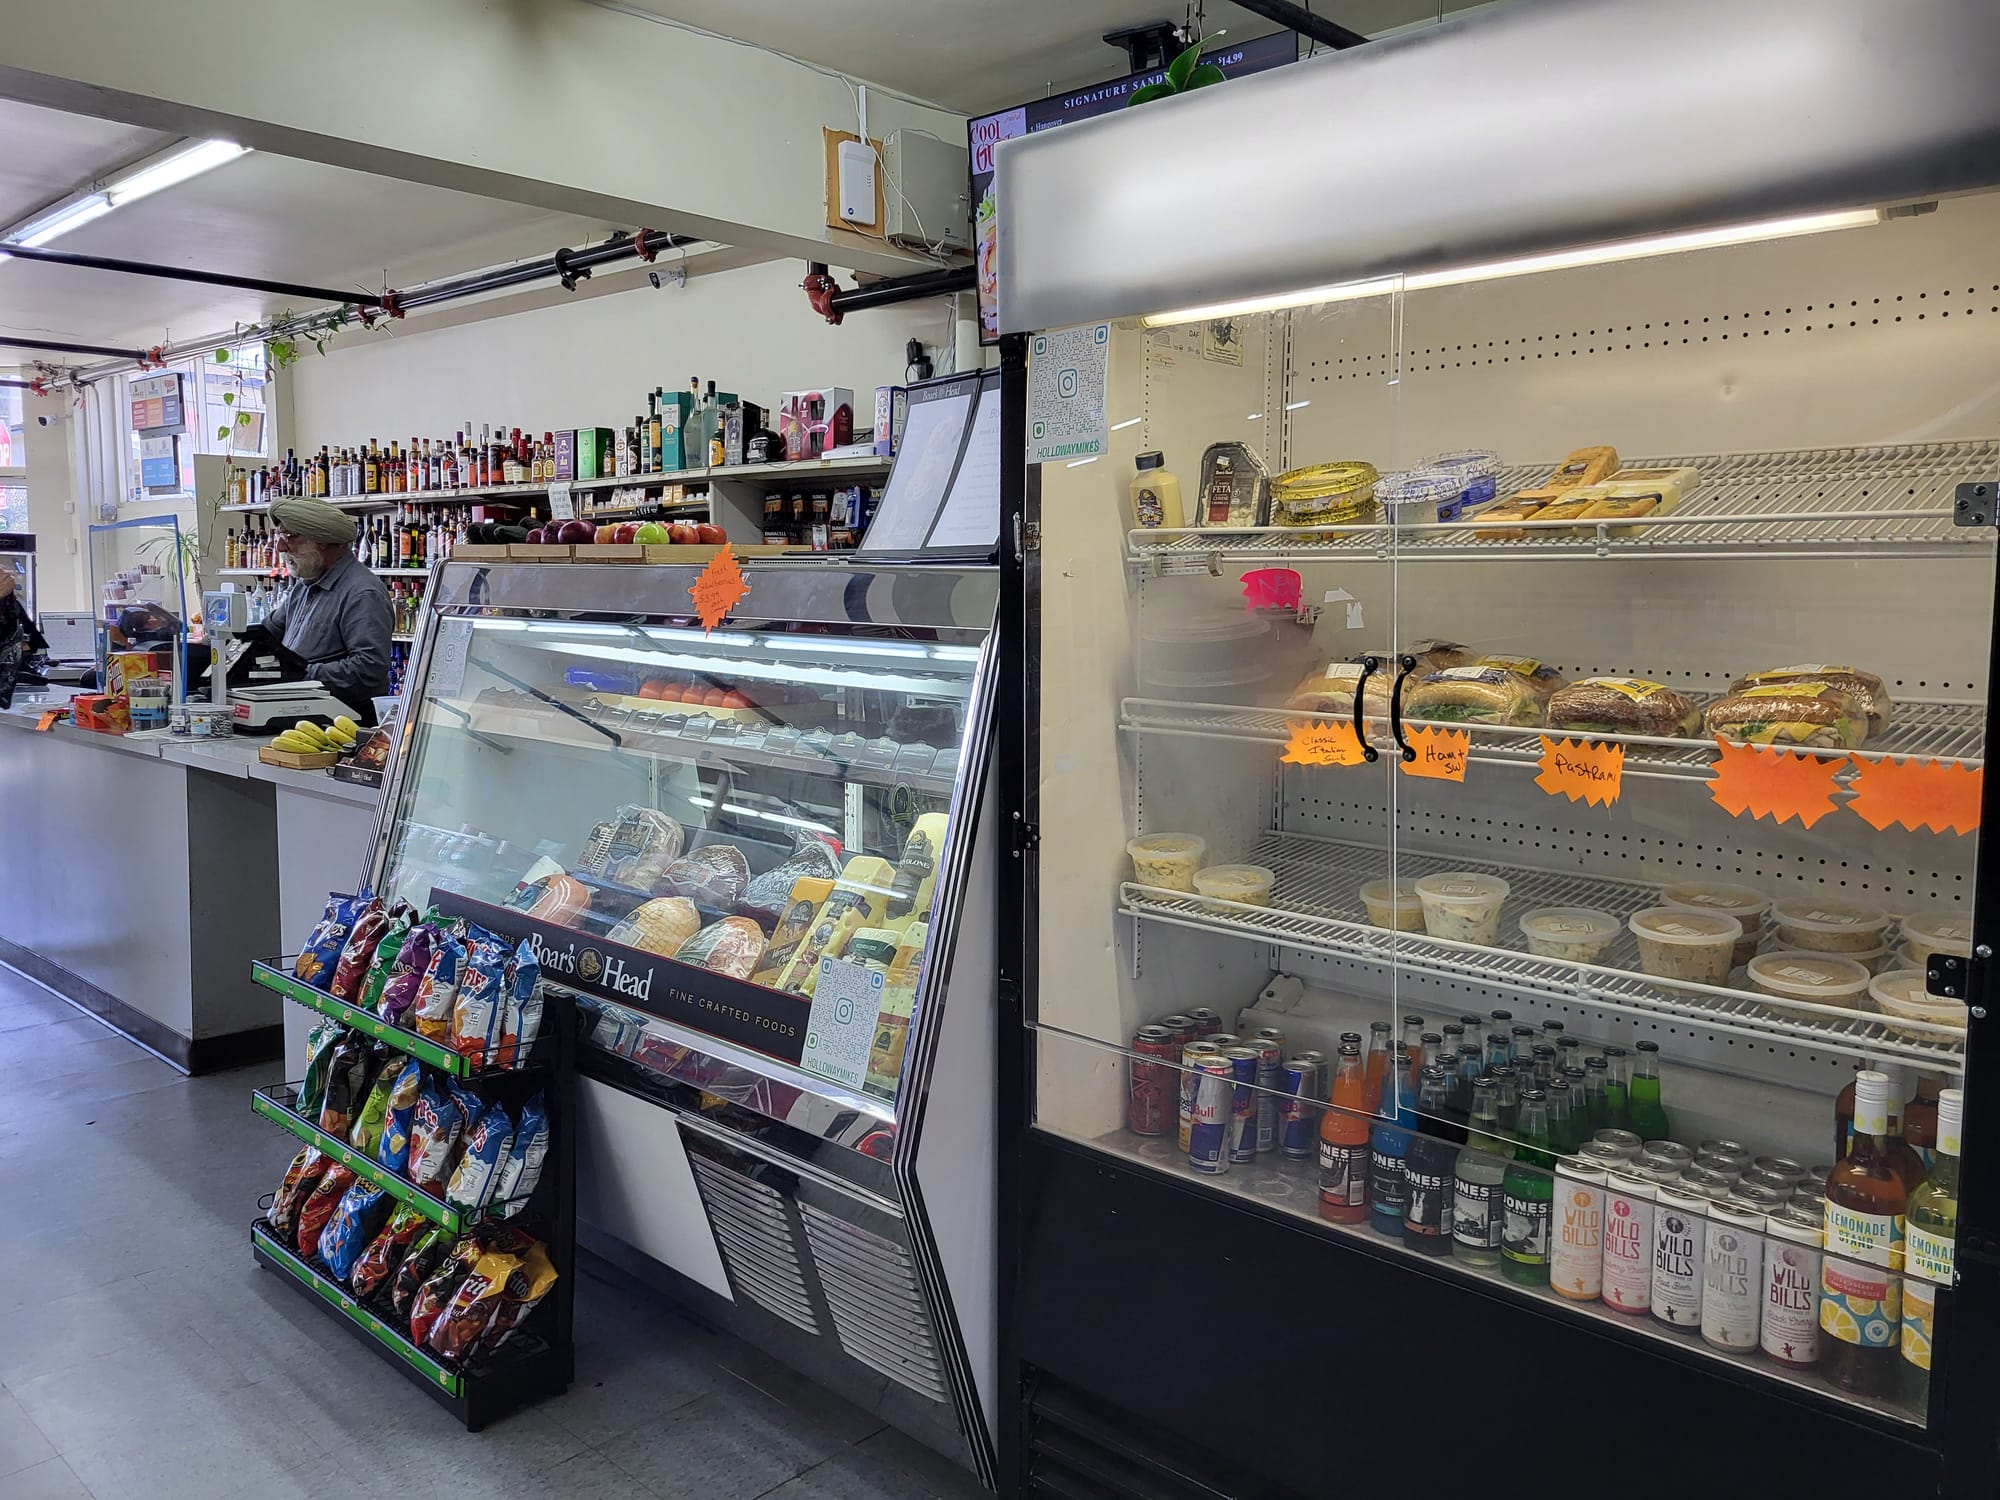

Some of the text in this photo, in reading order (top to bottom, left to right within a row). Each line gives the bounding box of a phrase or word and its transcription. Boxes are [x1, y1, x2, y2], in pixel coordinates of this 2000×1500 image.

[1064, 51, 1244, 109] SIGNATURE SAND $14.99
[976, 143, 995, 171] GU
[1036, 438, 1100, 459] HOLLOWAYMIKES
[1212, 485, 1231, 493] FETA
[530, 932, 796, 1038] Boar's Head FINE CRAFTED FOODS
[806, 1055, 860, 1085] HOLLOWAYMIKES
[1320, 1141, 1350, 1159] ONES
[1372, 1151, 1405, 1169] ONES
[1404, 1169, 1441, 1187] ONES
[1454, 1178, 1489, 1197] ONES
[1565, 1206, 1598, 1228] WILD
[1607, 1214, 1640, 1241] WILD
[1830, 1210, 1886, 1237] LEMONADE
[1658, 1230, 1693, 1257] WILD
[1839, 1230, 1874, 1250] STAND
[1711, 1248, 1747, 1276] WILD
[1773, 1263, 1810, 1290] WILD
